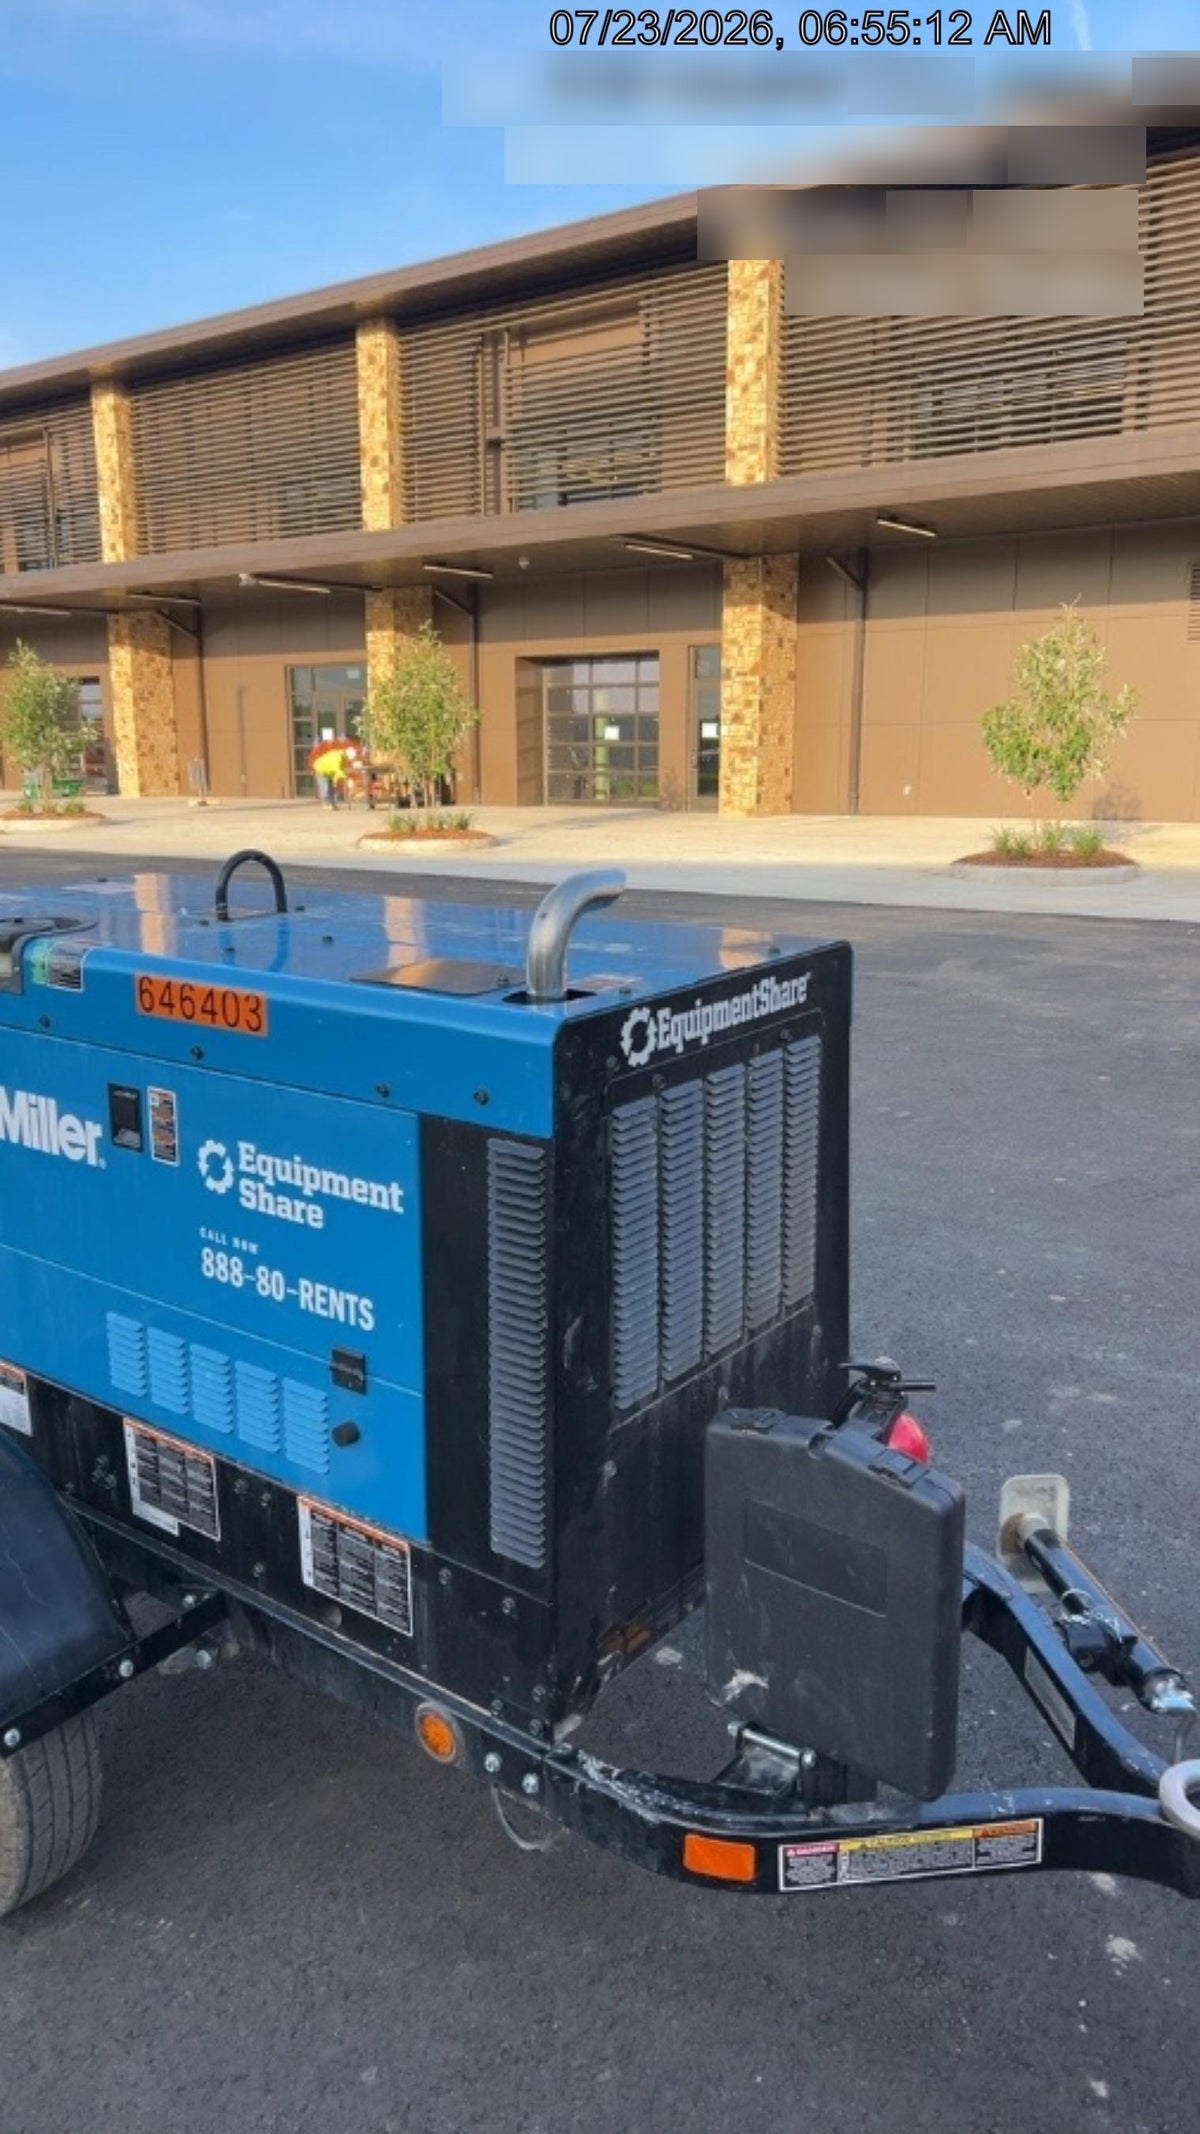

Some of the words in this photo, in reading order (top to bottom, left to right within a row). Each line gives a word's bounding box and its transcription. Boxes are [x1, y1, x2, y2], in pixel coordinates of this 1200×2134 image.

[139, 976, 264, 1032] 646403
[657, 974, 809, 1053] EquipmentShare
[0, 1086, 103, 1167] Miller
[237, 1141, 404, 1213] Equipment
[238, 1180, 324, 1229] Share
[199, 1226, 228, 1245] CALL
[201, 1248, 376, 1332] 888-80-RENTS
